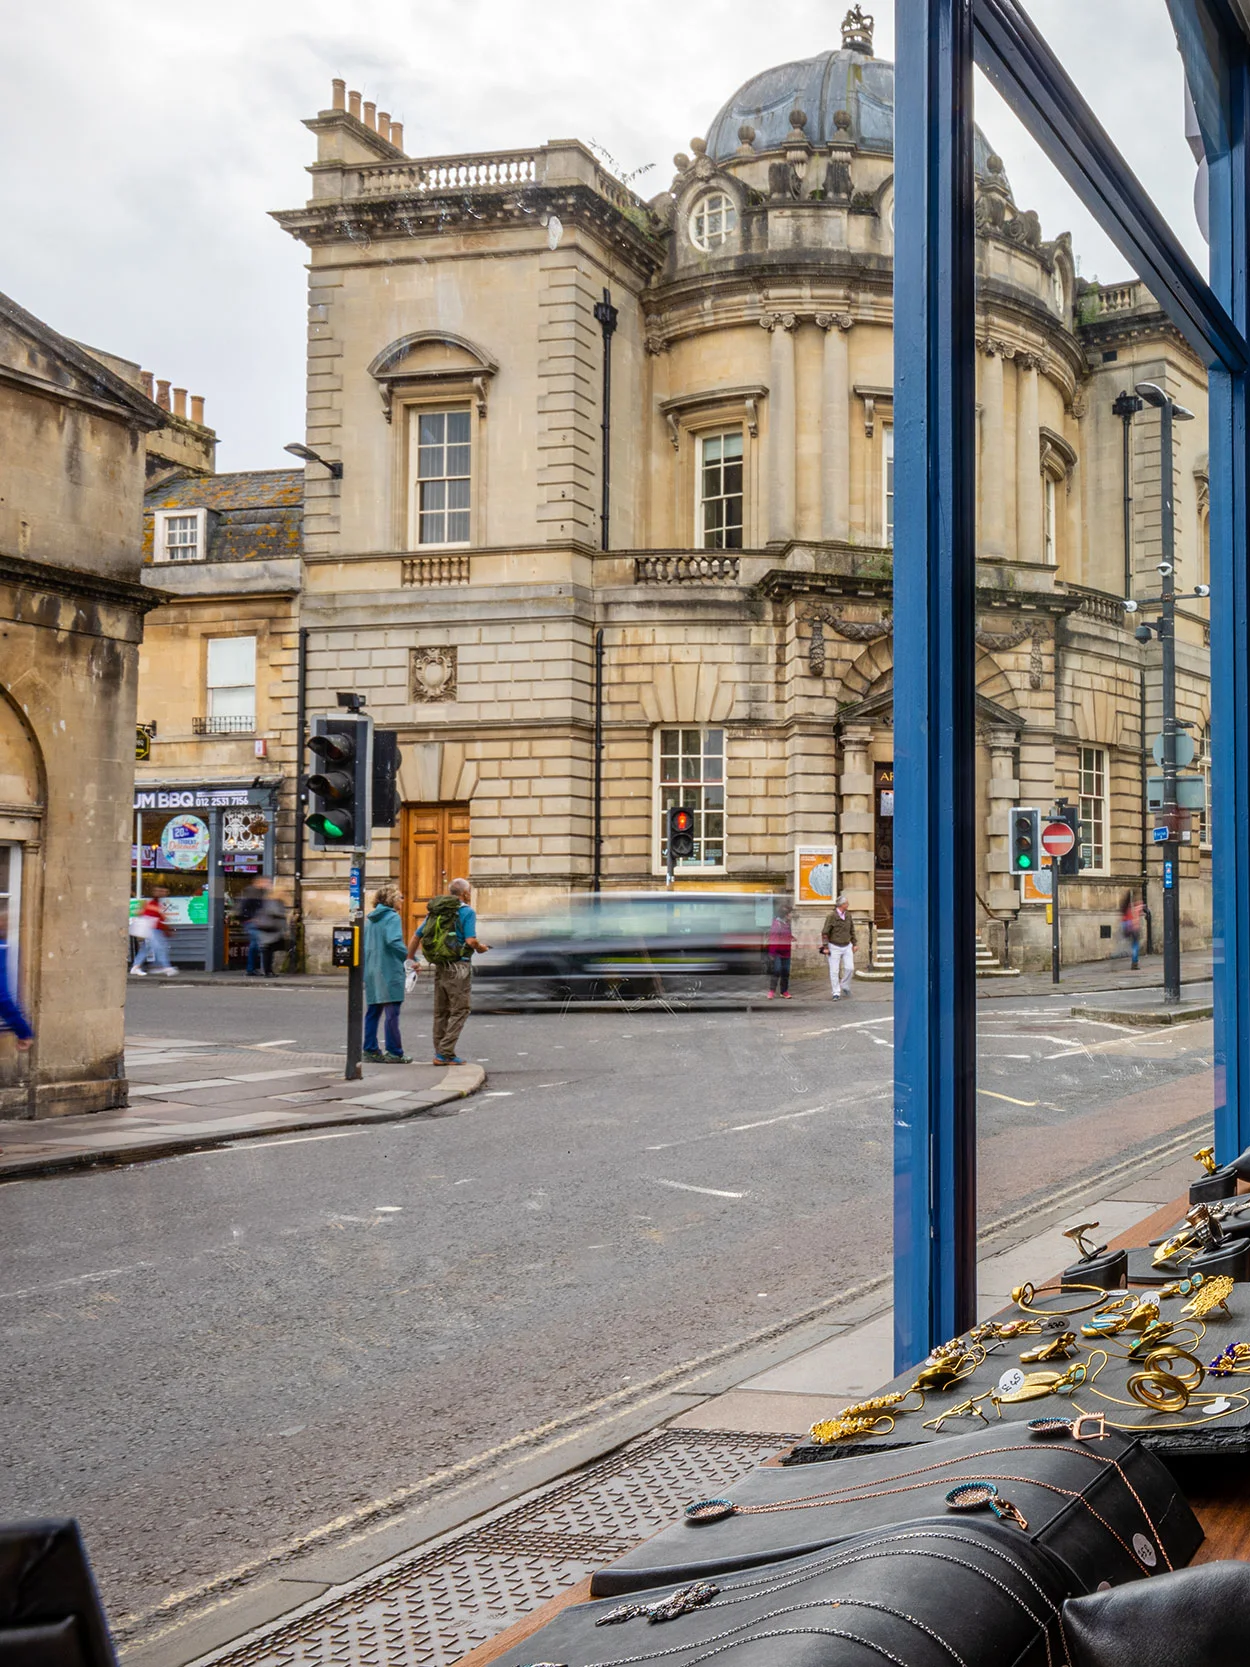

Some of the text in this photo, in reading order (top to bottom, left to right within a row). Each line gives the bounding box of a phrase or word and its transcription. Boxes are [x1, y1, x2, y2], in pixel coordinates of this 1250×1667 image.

[158, 791, 194, 808] BBQ
[196, 796, 249, 807] 012 2531 7156
